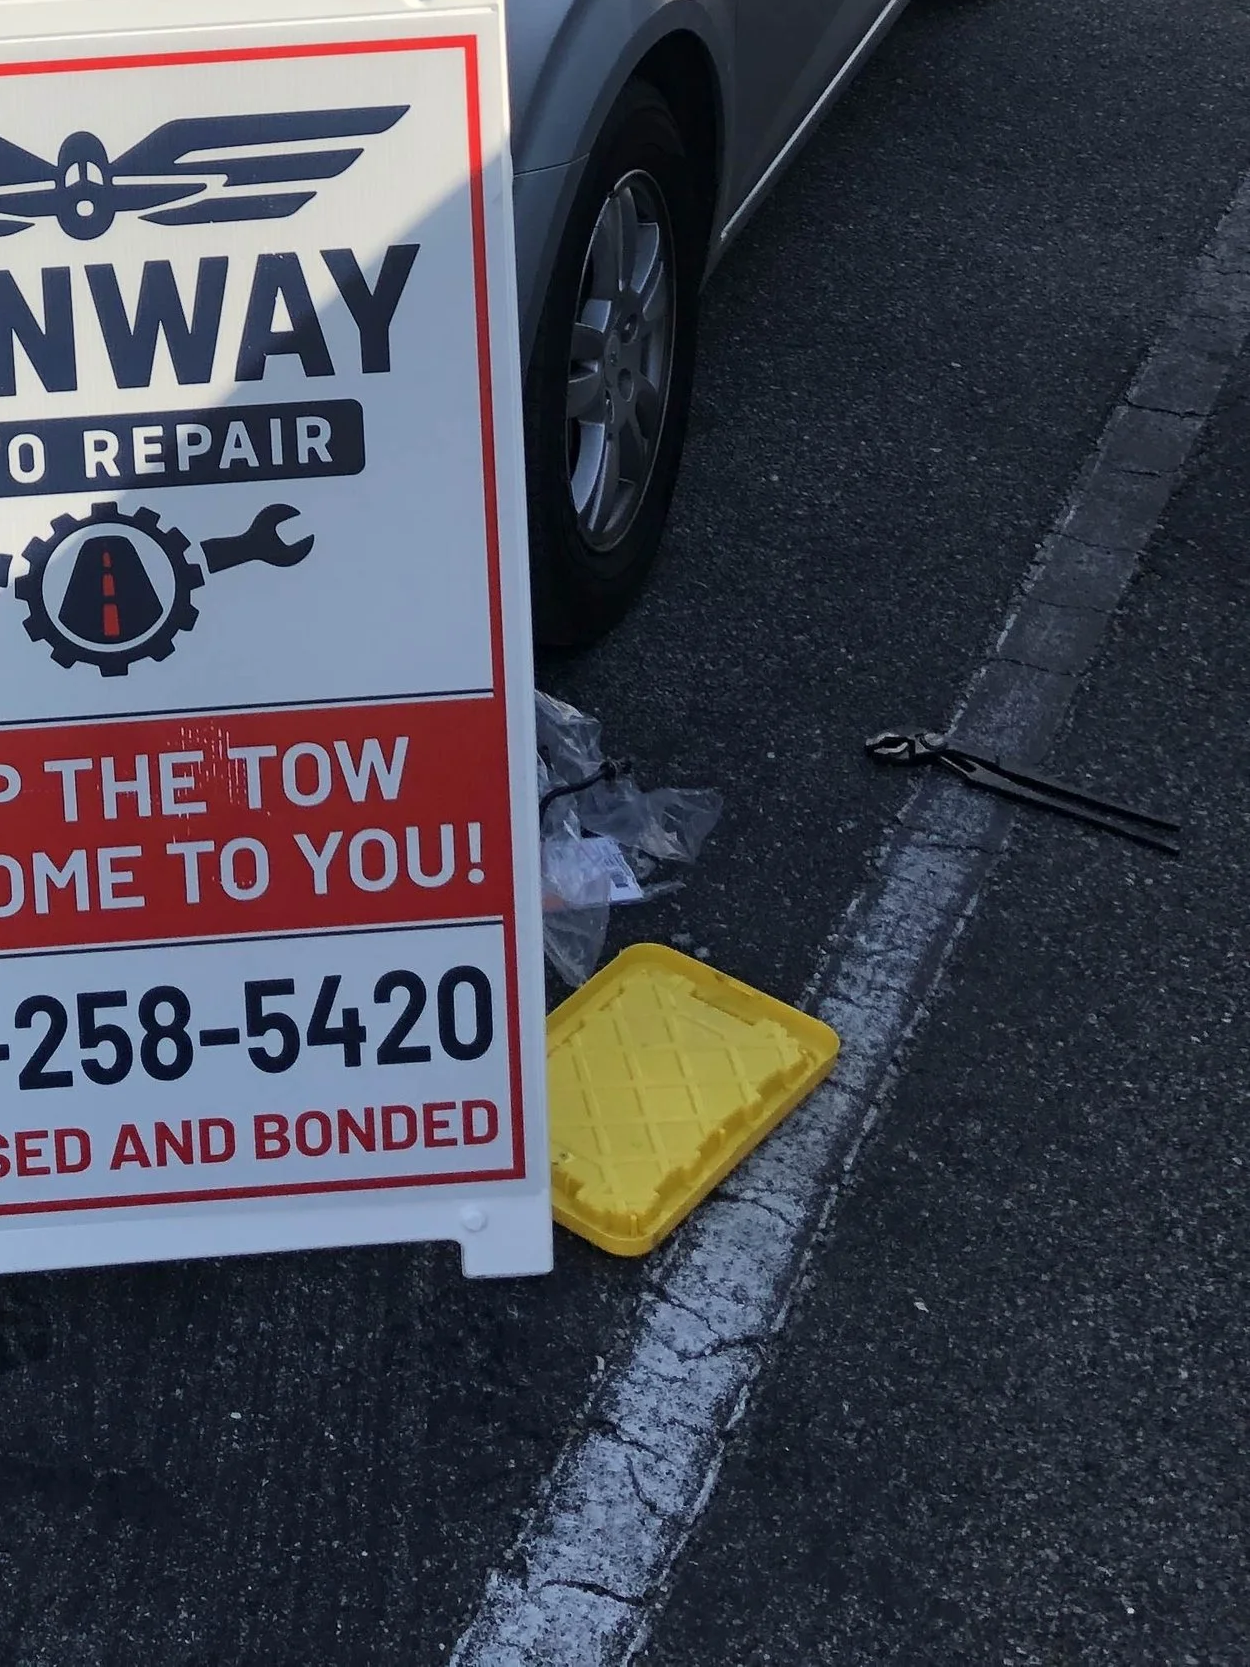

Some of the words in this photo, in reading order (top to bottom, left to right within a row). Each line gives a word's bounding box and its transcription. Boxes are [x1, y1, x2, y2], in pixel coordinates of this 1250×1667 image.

[83, 415, 334, 480] REPAIR
[44, 750, 207, 824] THE
[226, 736, 410, 809] TOW
[166, 836, 270, 905] TO
[292, 821, 487, 896] YOU!
[108, 1116, 237, 1171] AND
[253, 1098, 499, 1161] BONDED
